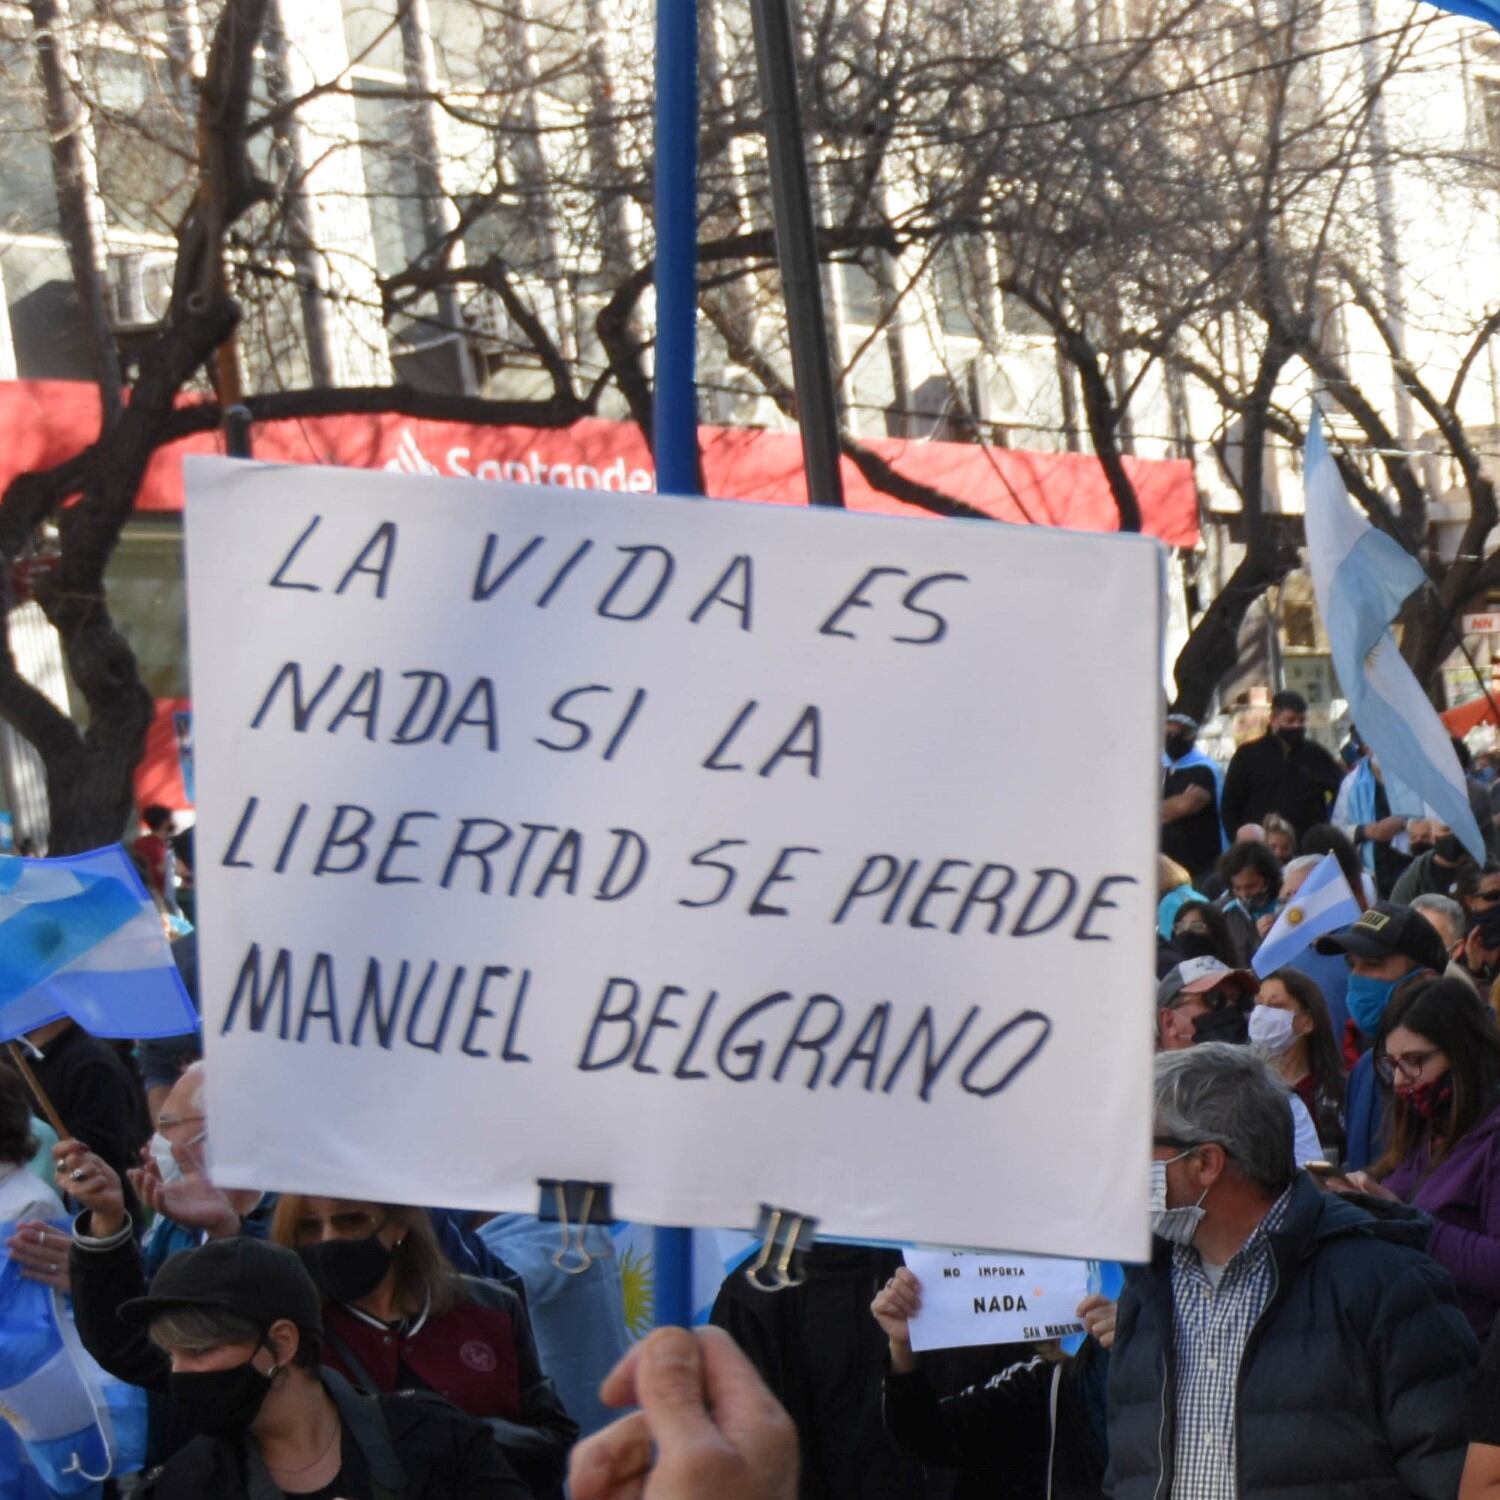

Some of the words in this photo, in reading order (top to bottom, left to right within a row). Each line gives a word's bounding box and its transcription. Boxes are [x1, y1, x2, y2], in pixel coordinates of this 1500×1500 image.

[446, 446, 657, 495] Santande
[270, 517, 395, 597] LA
[472, 534, 751, 630] VIDA
[820, 568, 966, 643] ES
[252, 663, 497, 751] NADA
[537, 685, 644, 760] SI
[703, 701, 819, 776] LA
[223, 798, 646, 900] LIBERTAD
[679, 840, 818, 915] SE
[833, 855, 1135, 940] PIERDE
[222, 943, 529, 1062] MANUEL
[578, 978, 1050, 1102] BELGRANO
[943, 1267, 960, 1278] NO
[978, 1266, 1025, 1277] IMPORTA
[973, 1295, 1027, 1314] NADA
[1023, 1326, 1040, 1339] SAN
